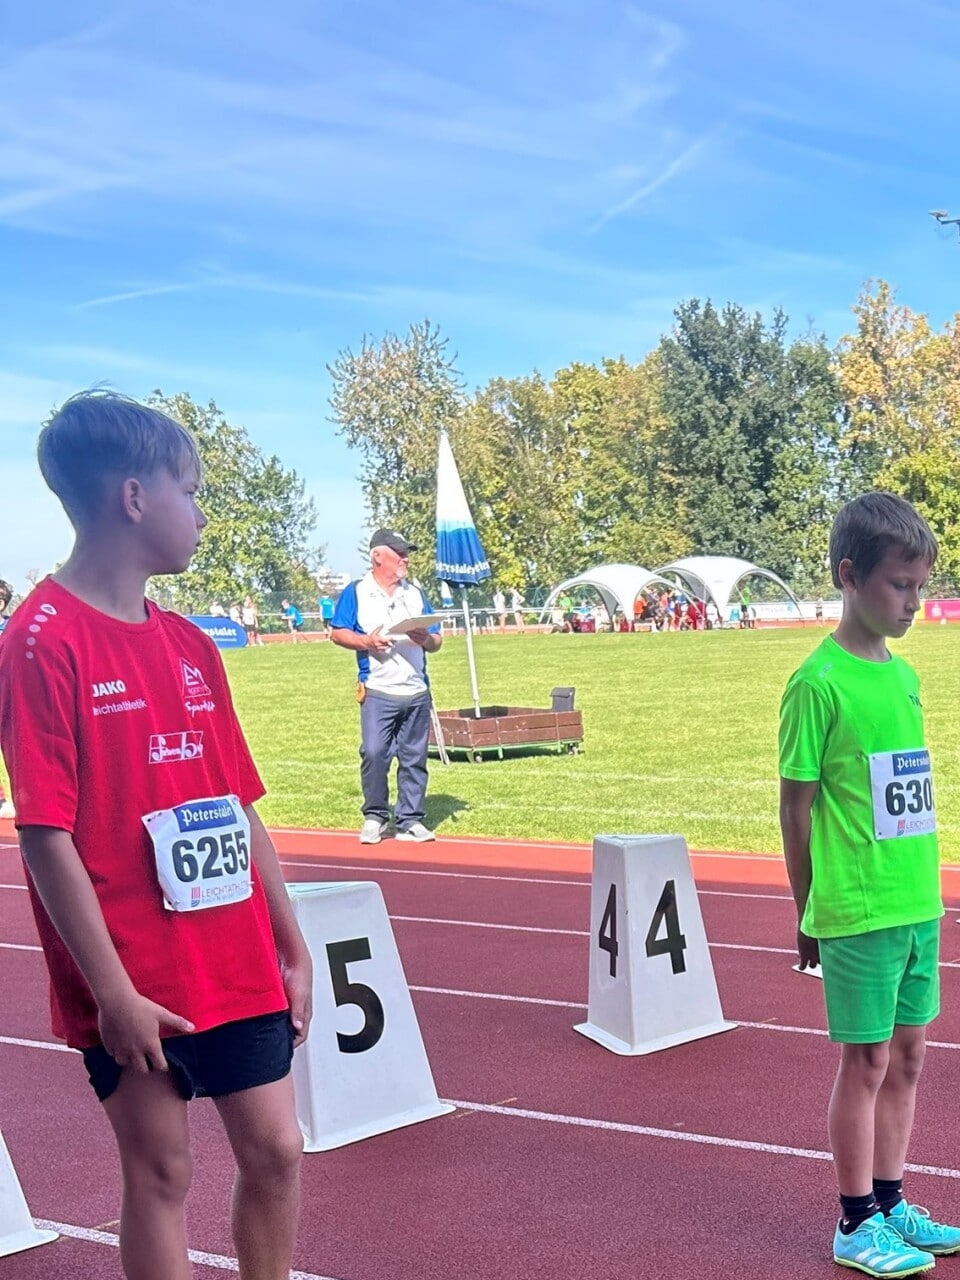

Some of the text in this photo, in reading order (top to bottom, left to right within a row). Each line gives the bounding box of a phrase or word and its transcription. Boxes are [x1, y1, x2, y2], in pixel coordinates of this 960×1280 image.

[92, 679, 127, 698] JAKO
[885, 777, 936, 817] 630
[171, 829, 249, 883] 6255
[599, 883, 619, 979] 4
[645, 879, 688, 976] 4
[325, 937, 386, 1054] 5
